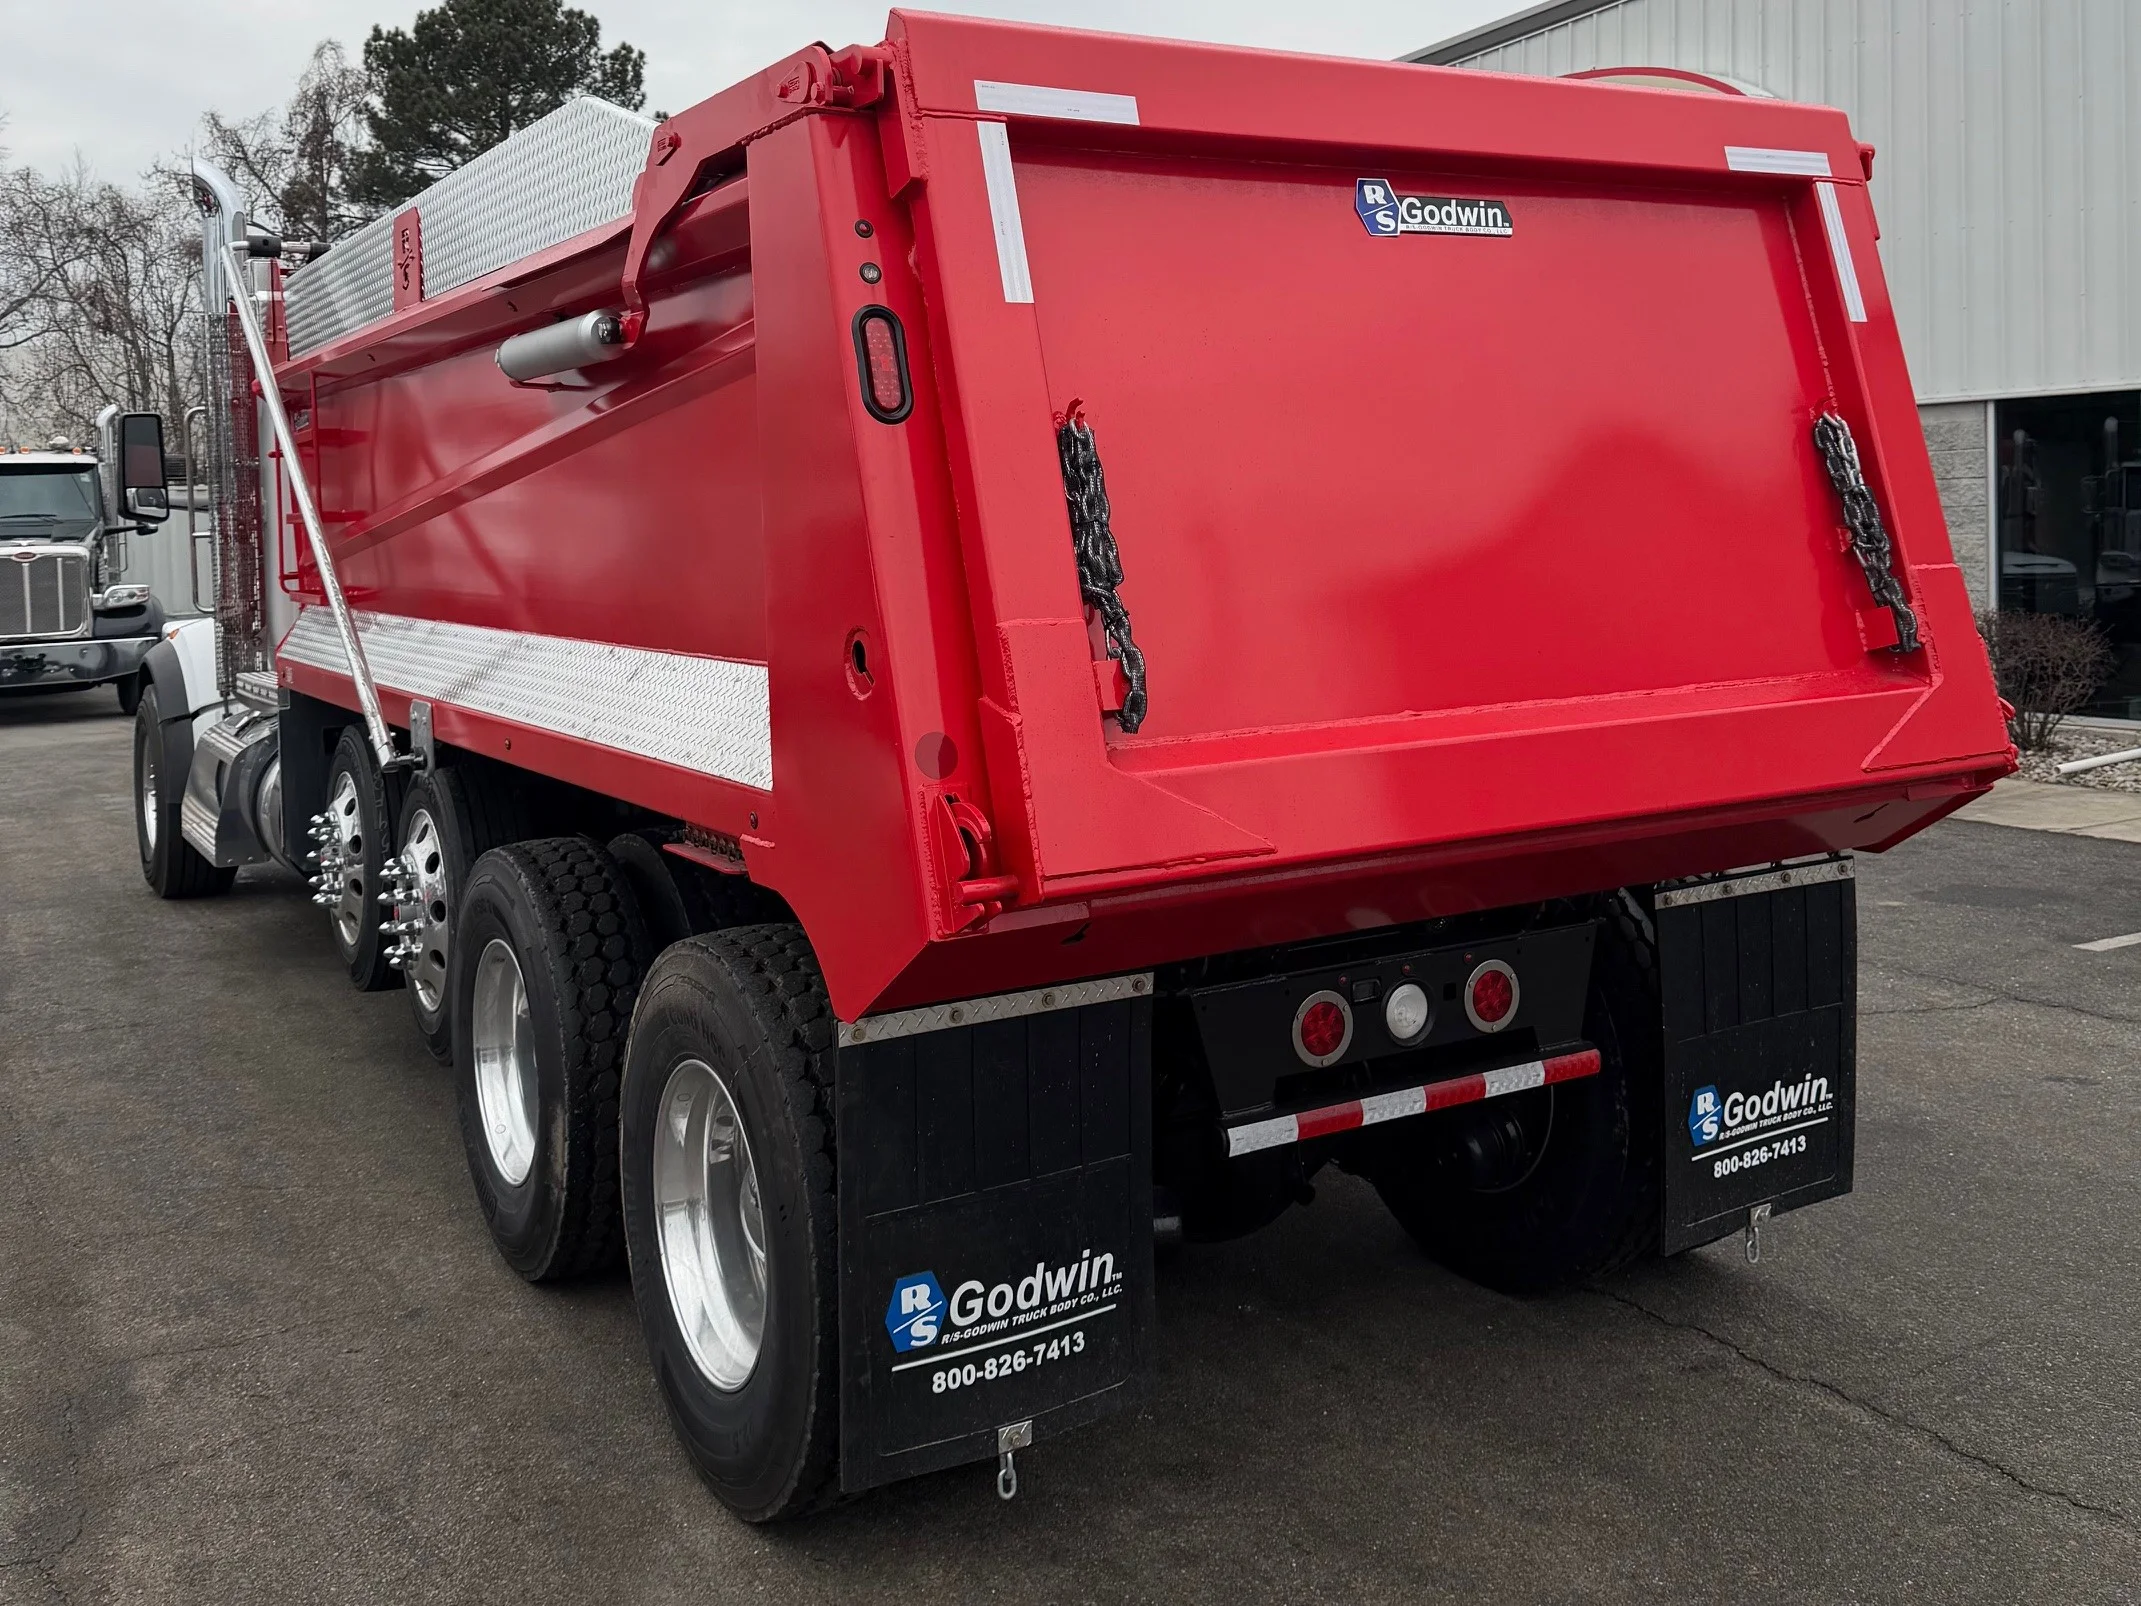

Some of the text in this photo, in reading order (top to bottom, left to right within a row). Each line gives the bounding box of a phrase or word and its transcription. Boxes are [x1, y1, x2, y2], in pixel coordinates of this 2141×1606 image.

[1401, 197, 1503, 228] Godwin
[1723, 1073, 1829, 1128] Godwin
[1759, 1115, 1782, 1130] TRUCK
[1783, 1109, 1802, 1121] BODY
[1713, 1135, 1807, 1178] 800-826-7413
[941, 1317, 1008, 1345] R/S-GODWIN
[1012, 1306, 1048, 1327] TRUCK
[1050, 1298, 1078, 1315] BODY
[1102, 1285, 1123, 1299] LLC.
[950, 1249, 1114, 1327] Godwin
[932, 1331, 1086, 1393] 800-826-7413
